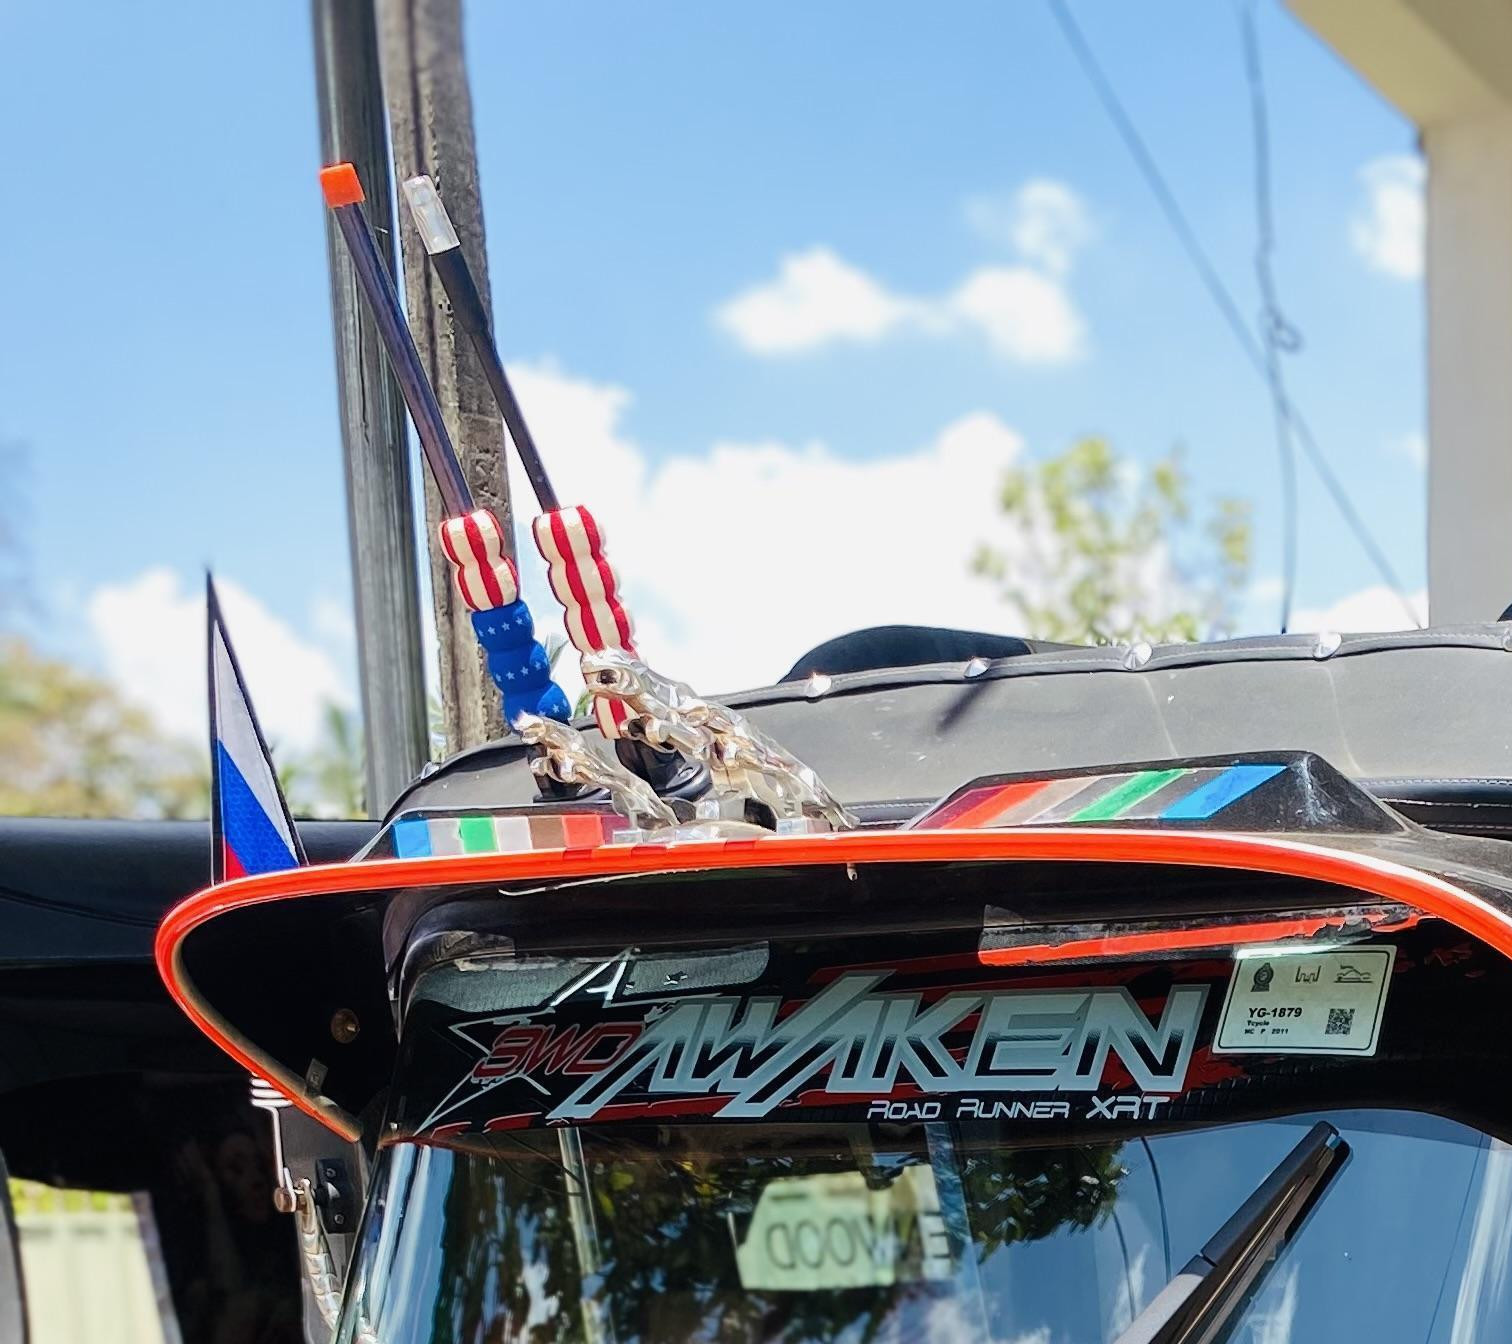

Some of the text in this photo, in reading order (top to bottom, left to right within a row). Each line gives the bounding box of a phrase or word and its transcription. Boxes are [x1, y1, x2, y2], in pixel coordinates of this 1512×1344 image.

[1249, 1007, 1303, 1018] YG-1879
[545, 968, 1212, 1119] AWAKEN
[1086, 1095, 1171, 1120] XRT
